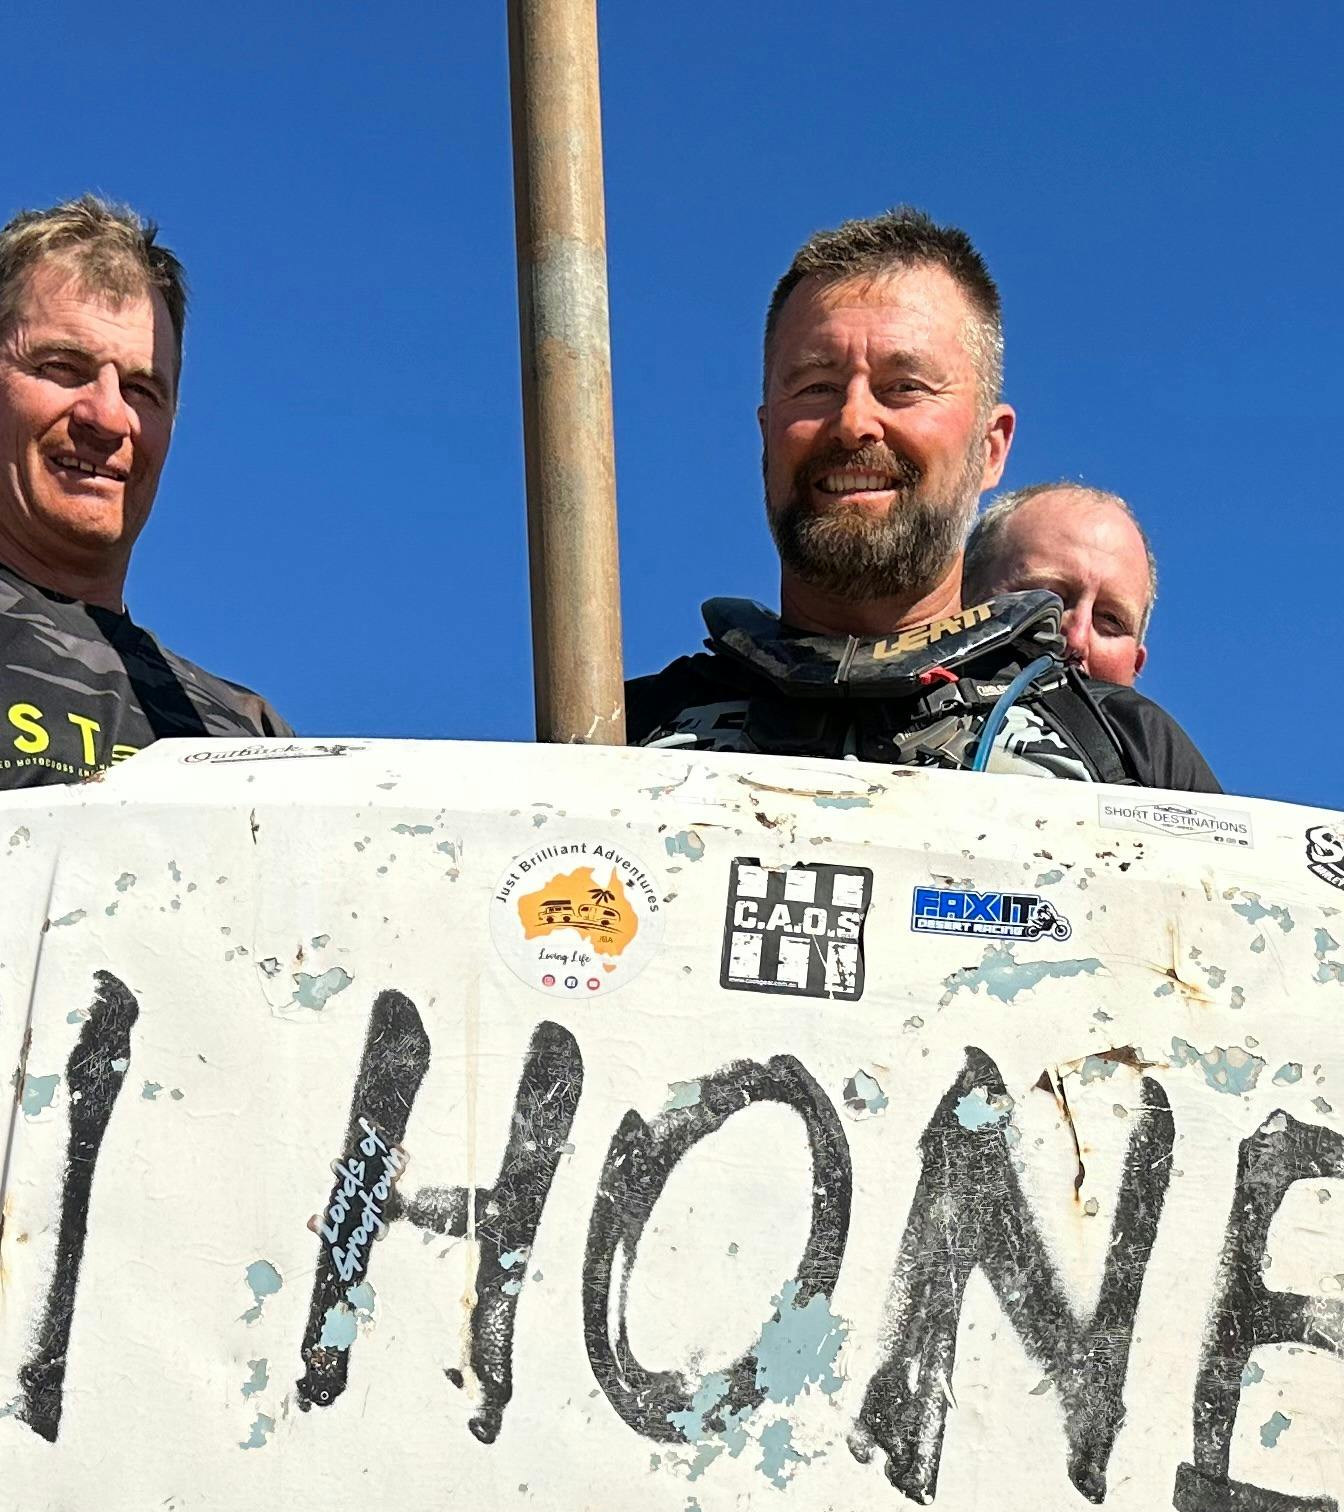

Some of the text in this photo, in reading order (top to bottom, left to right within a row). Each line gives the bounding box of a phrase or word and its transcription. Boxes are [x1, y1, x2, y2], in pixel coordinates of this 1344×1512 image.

[1104, 806, 1148, 820] SHORT
[1153, 812, 1248, 834] DESTINATIONS
[496, 843, 659, 912] Just Brilliant Adventures
[917, 919, 1025, 936] DESERT RACING
[538, 948, 591, 966] Loving Life
[358, 1116, 388, 1157] of
